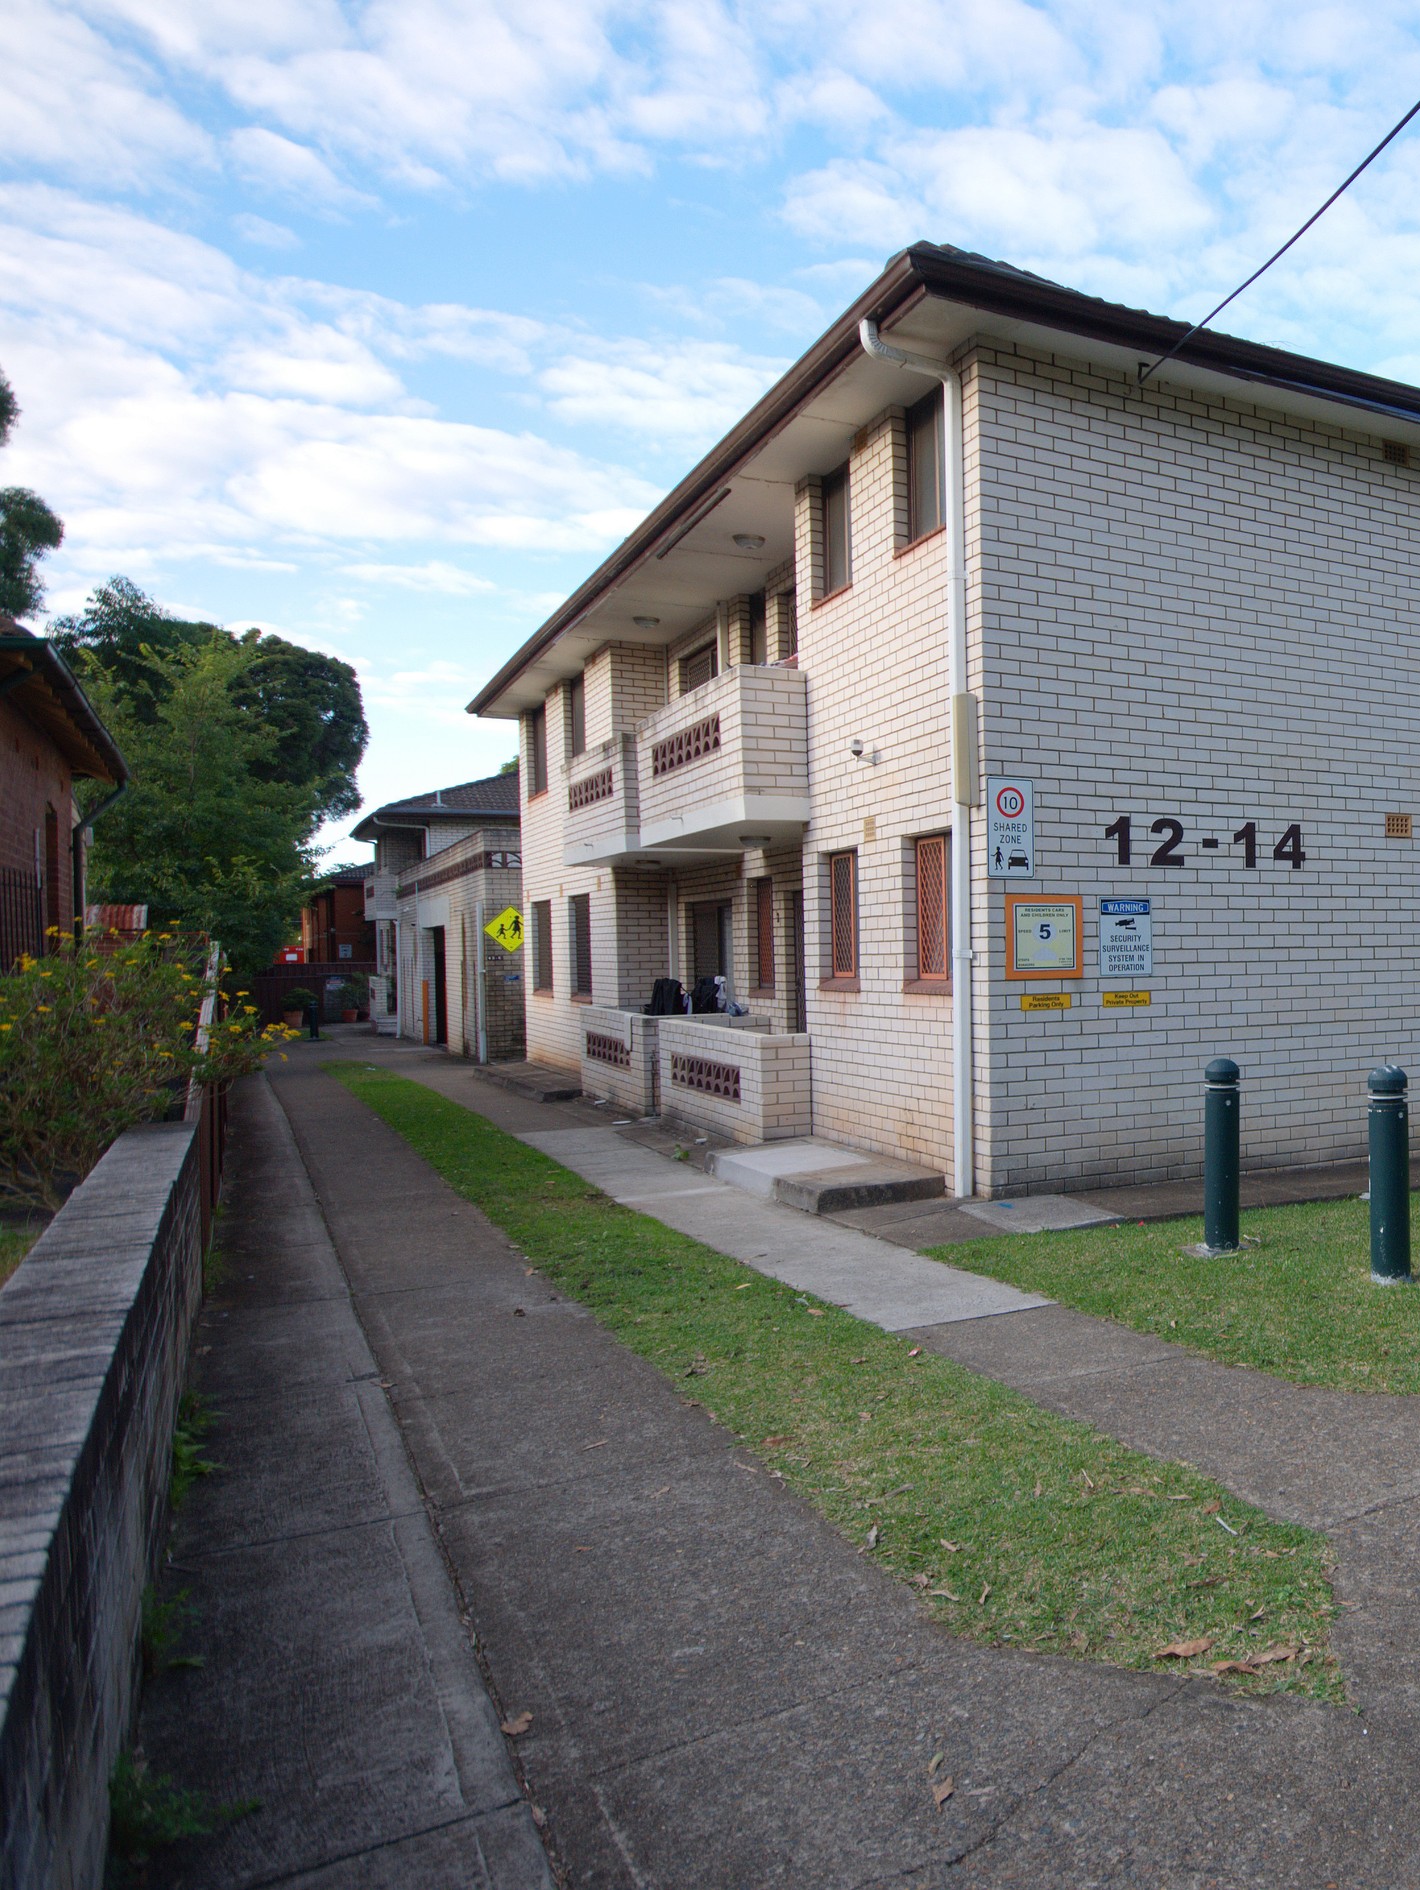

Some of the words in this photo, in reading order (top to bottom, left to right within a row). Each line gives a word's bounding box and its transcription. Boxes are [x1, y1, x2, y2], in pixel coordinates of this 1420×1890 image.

[1003, 796, 1018, 810] 10
[993, 822, 1028, 832] SHARED
[1000, 834, 1022, 844] ZONE
[1105, 816, 1305, 869] 12-14
[1107, 903, 1144, 912] WARNING
[1039, 923, 1052, 940] 5
[1110, 934, 1142, 943] SECURITY
[1102, 944, 1150, 953] SURVEILLANCE
[1108, 954, 1135, 962] SYSTEM
[1137, 954, 1145, 962] IN
[1108, 963, 1145, 972] OPERATION
